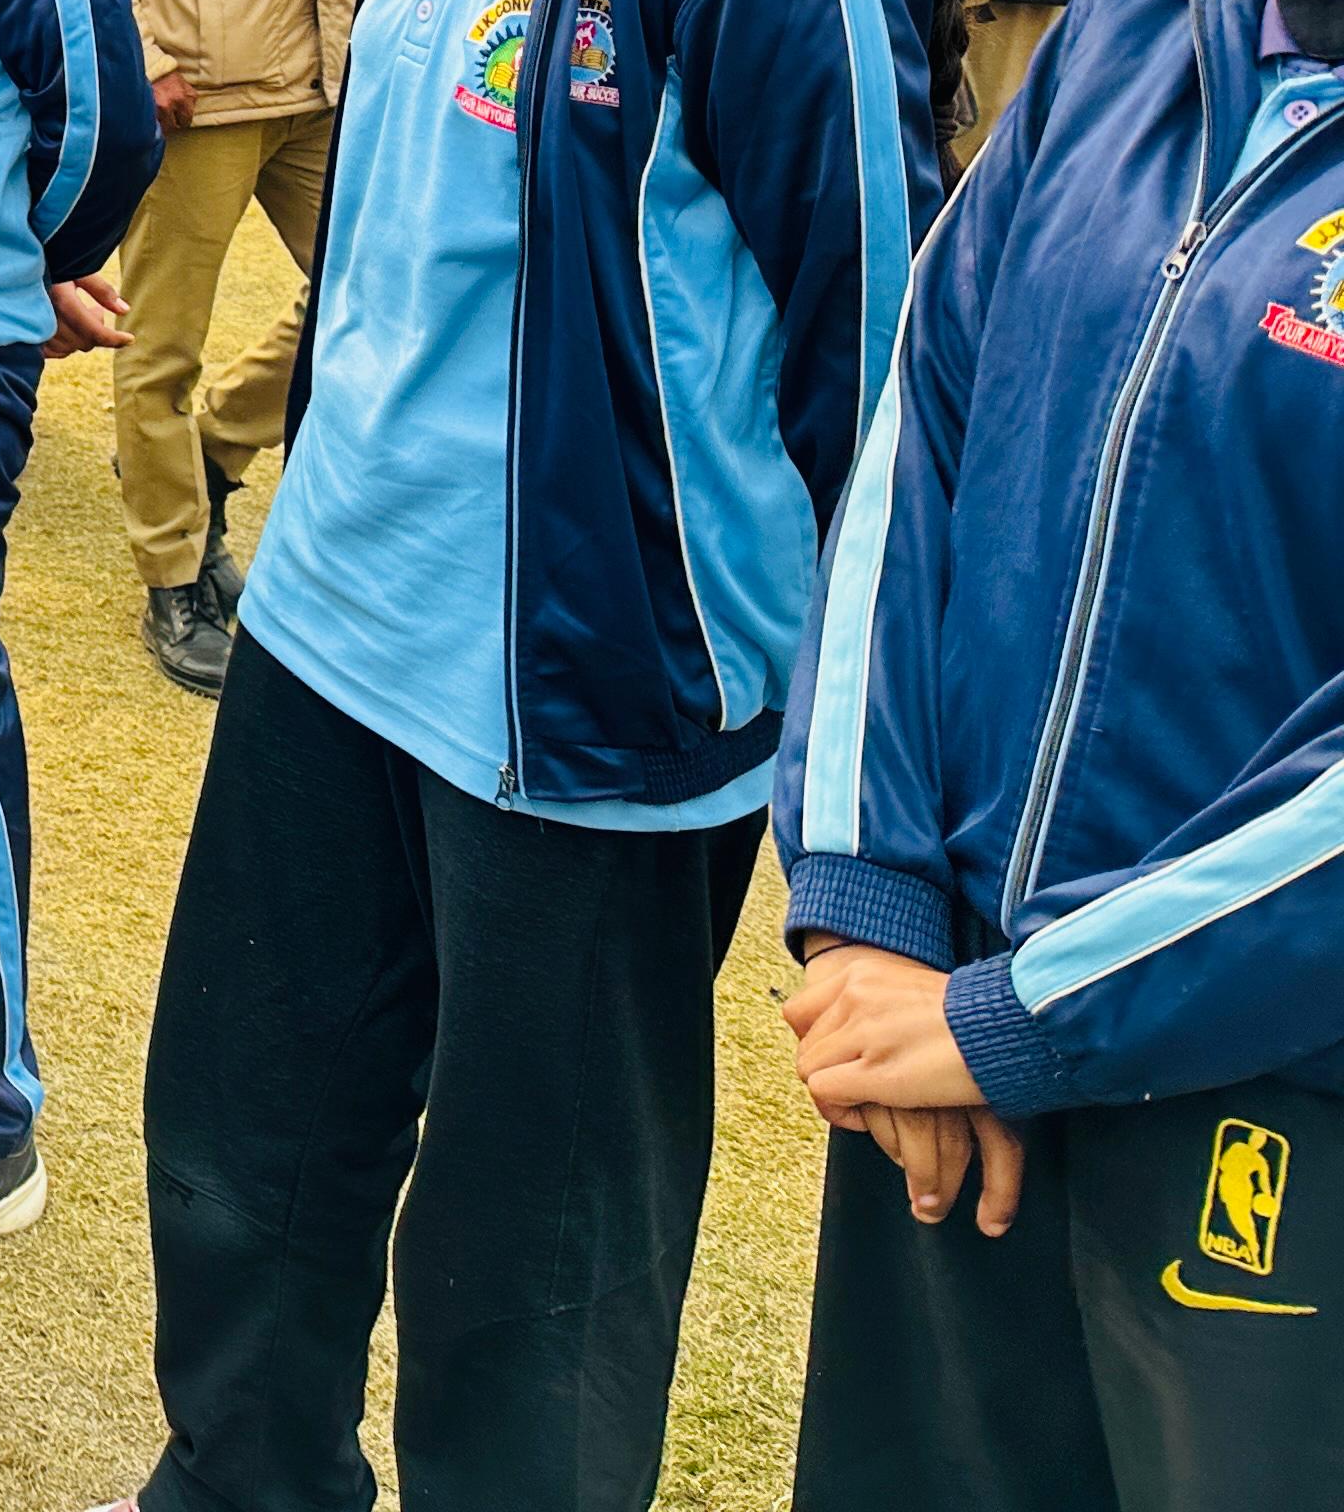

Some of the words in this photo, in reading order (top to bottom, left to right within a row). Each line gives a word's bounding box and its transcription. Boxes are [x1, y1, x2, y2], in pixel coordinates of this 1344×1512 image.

[587, 87, 618, 104] SUCCE
[1277, 320, 1304, 343] OUR
[1305, 330, 1330, 354] AIM
[1208, 1232, 1251, 1263] NBA
